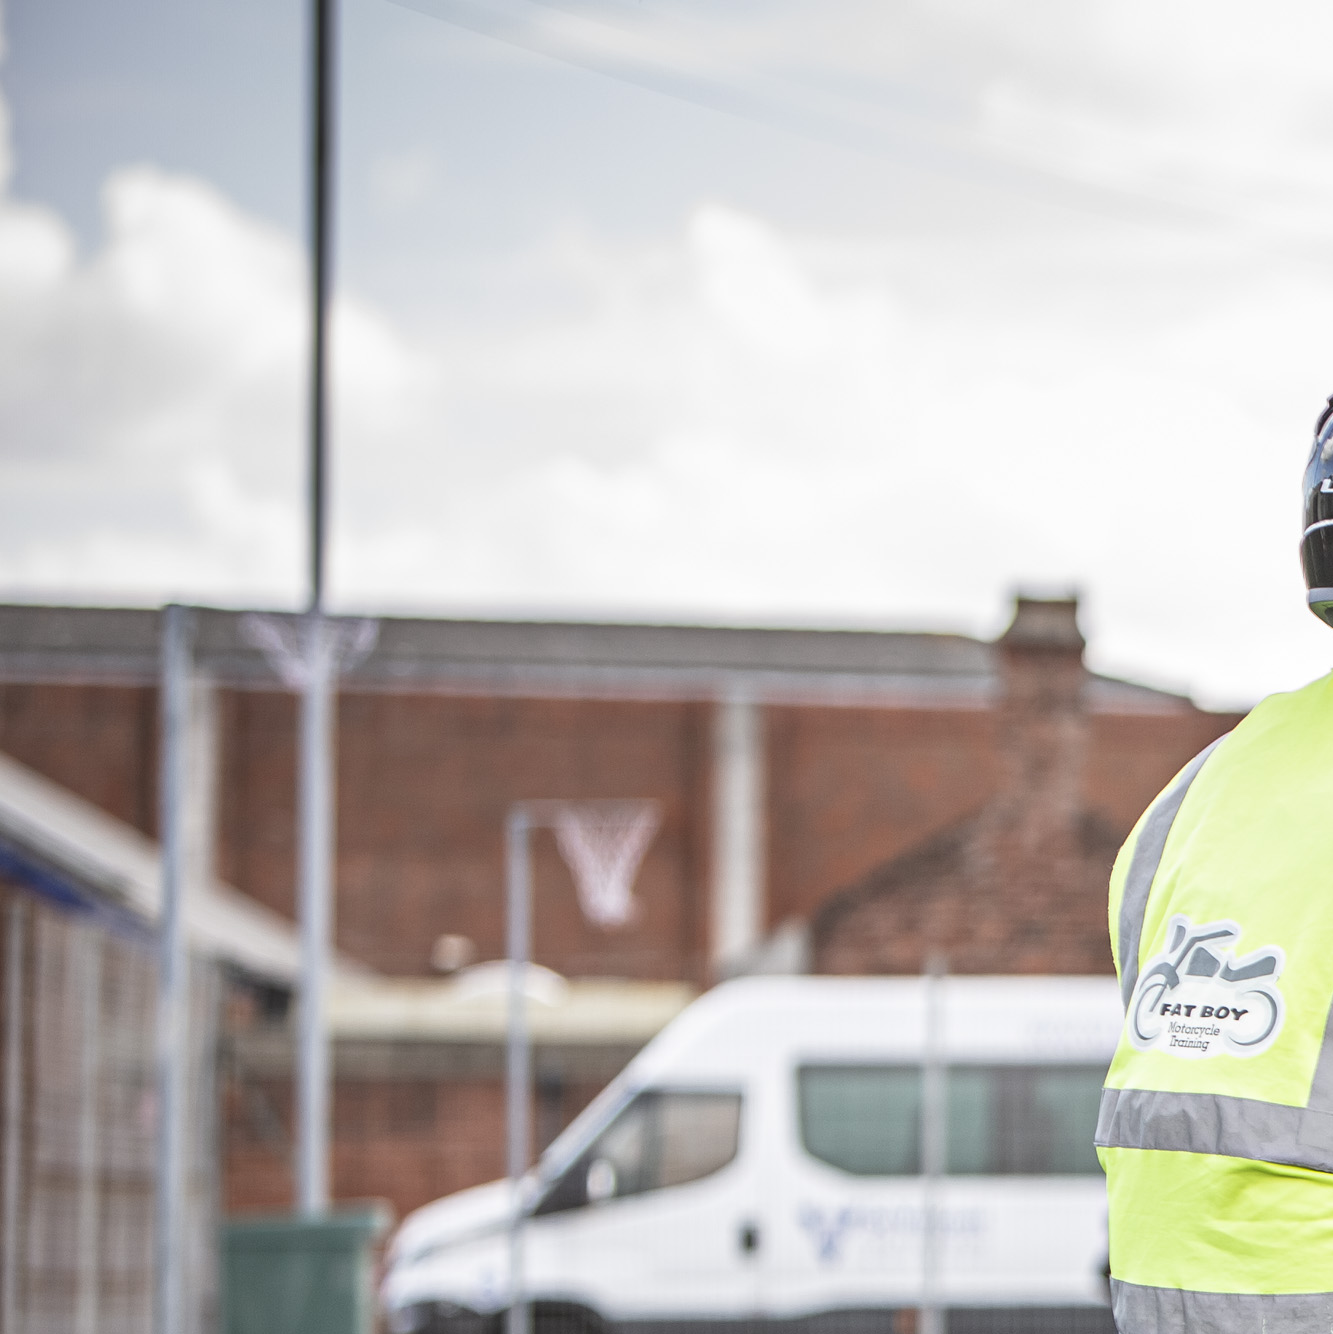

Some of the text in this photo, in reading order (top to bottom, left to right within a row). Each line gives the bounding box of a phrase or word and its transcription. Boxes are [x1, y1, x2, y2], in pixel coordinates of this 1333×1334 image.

[1160, 1003, 1249, 1021] FAT BOY
[1167, 1021, 1221, 1038] Motorcycle
[1168, 1035, 1210, 1052] Training
